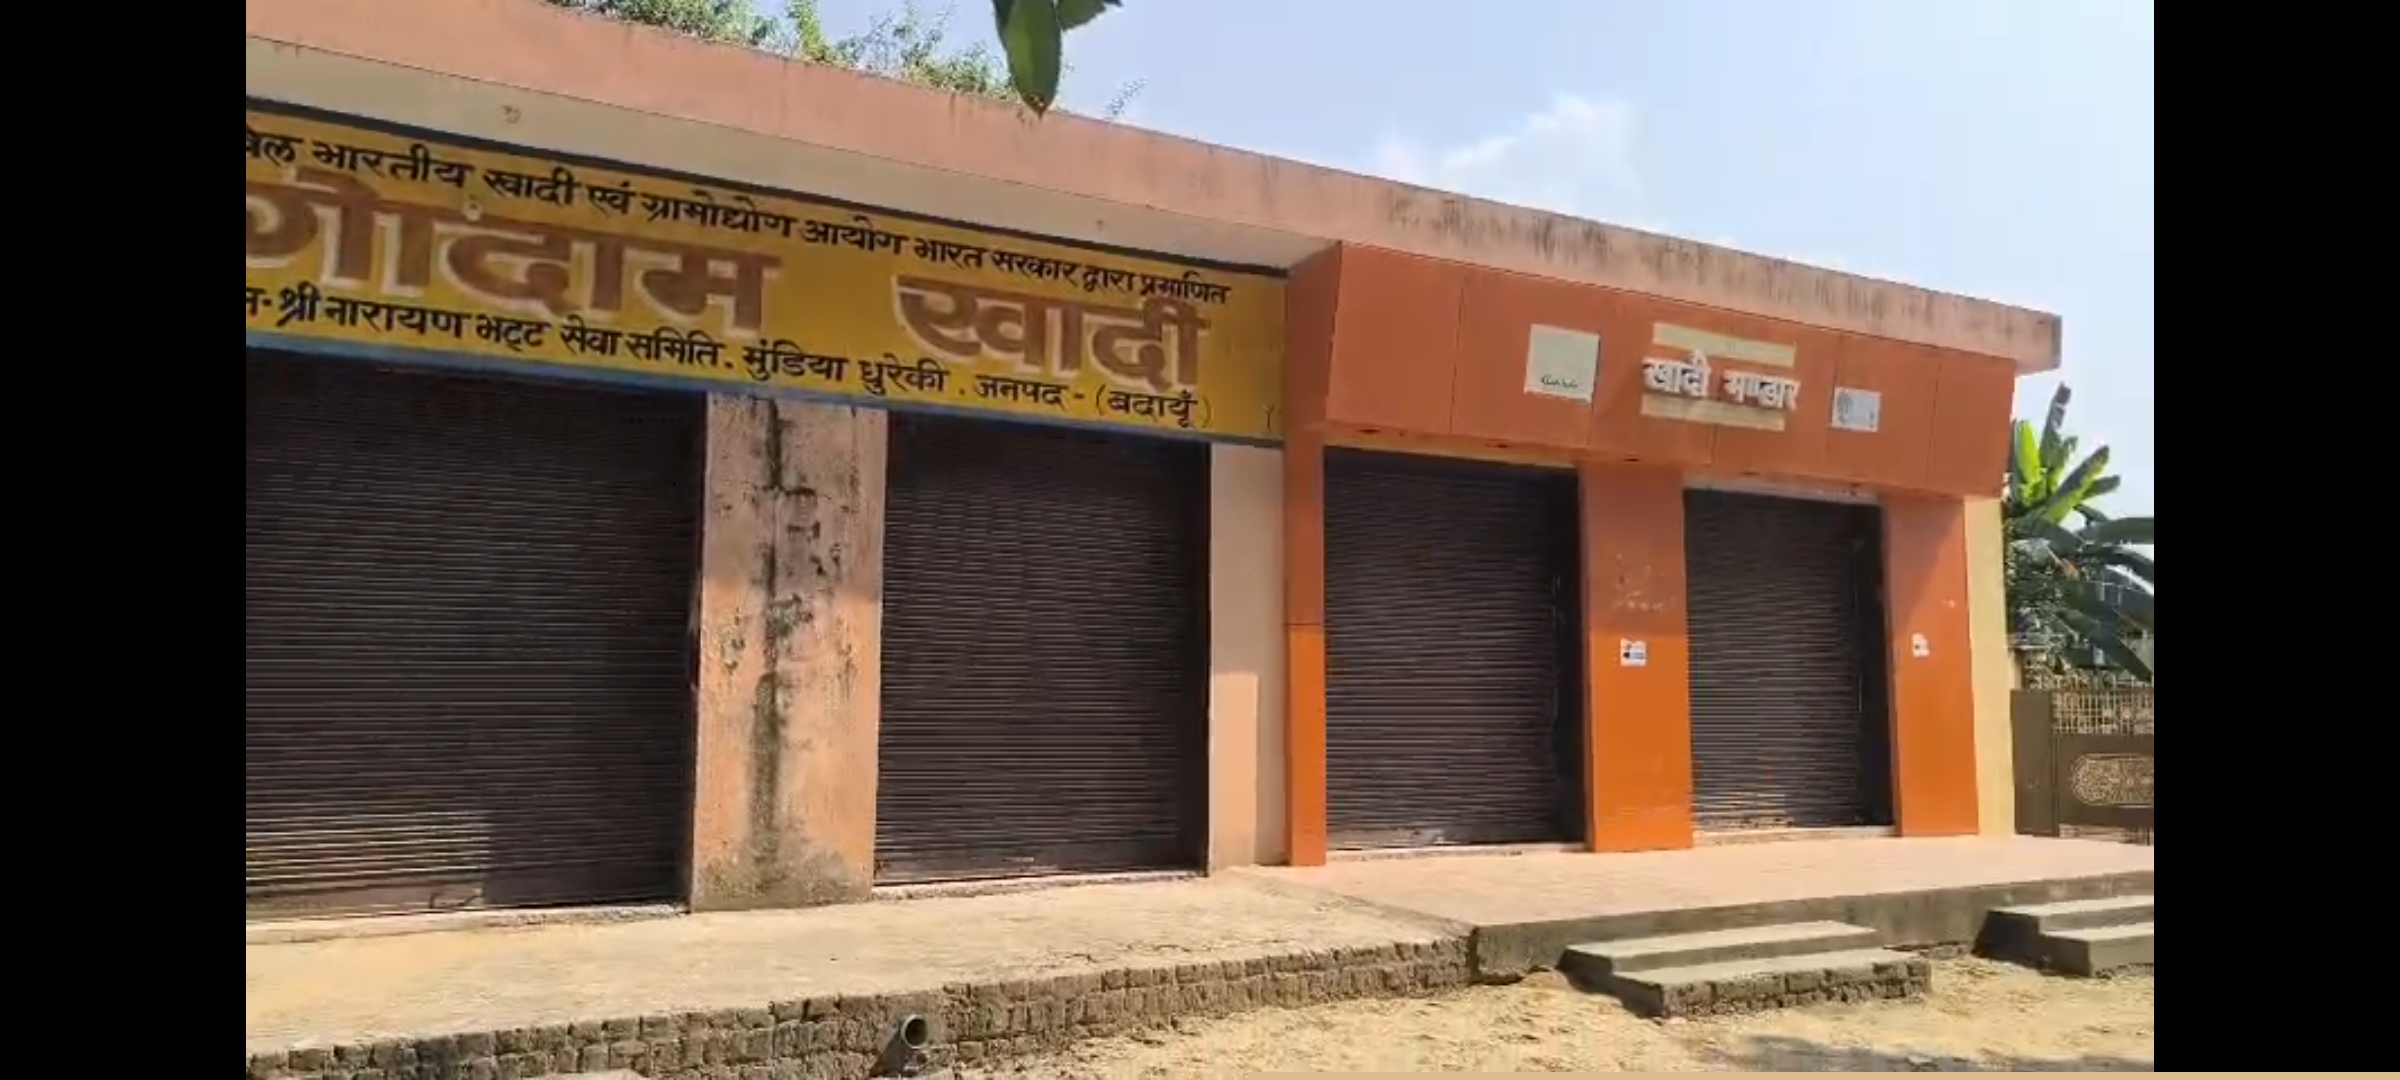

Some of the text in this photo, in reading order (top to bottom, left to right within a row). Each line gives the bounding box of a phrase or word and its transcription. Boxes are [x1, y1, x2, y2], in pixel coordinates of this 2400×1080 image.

[313, 144, 474, 189] भारतीय
[484, 167, 584, 206] खादी
[587, 180, 635, 216] एवं
[643, 190, 797, 238] ग्रामोद्योग
[800, 216, 911, 257] आयोग
[915, 237, 986, 269] भारत
[991, 252, 1080, 282] सरकार
[1082, 264, 1136, 293] द्वारा
[1139, 270, 1232, 303] प्रमाणित
[325, 297, 471, 338] नारायण
[560, 314, 622, 356] सेवा
[742, 337, 850, 383] मुंडिया
[976, 374, 1068, 412] जनपद
[893, 273, 1211, 392] खादी
[1641, 350, 1712, 397] खादी
